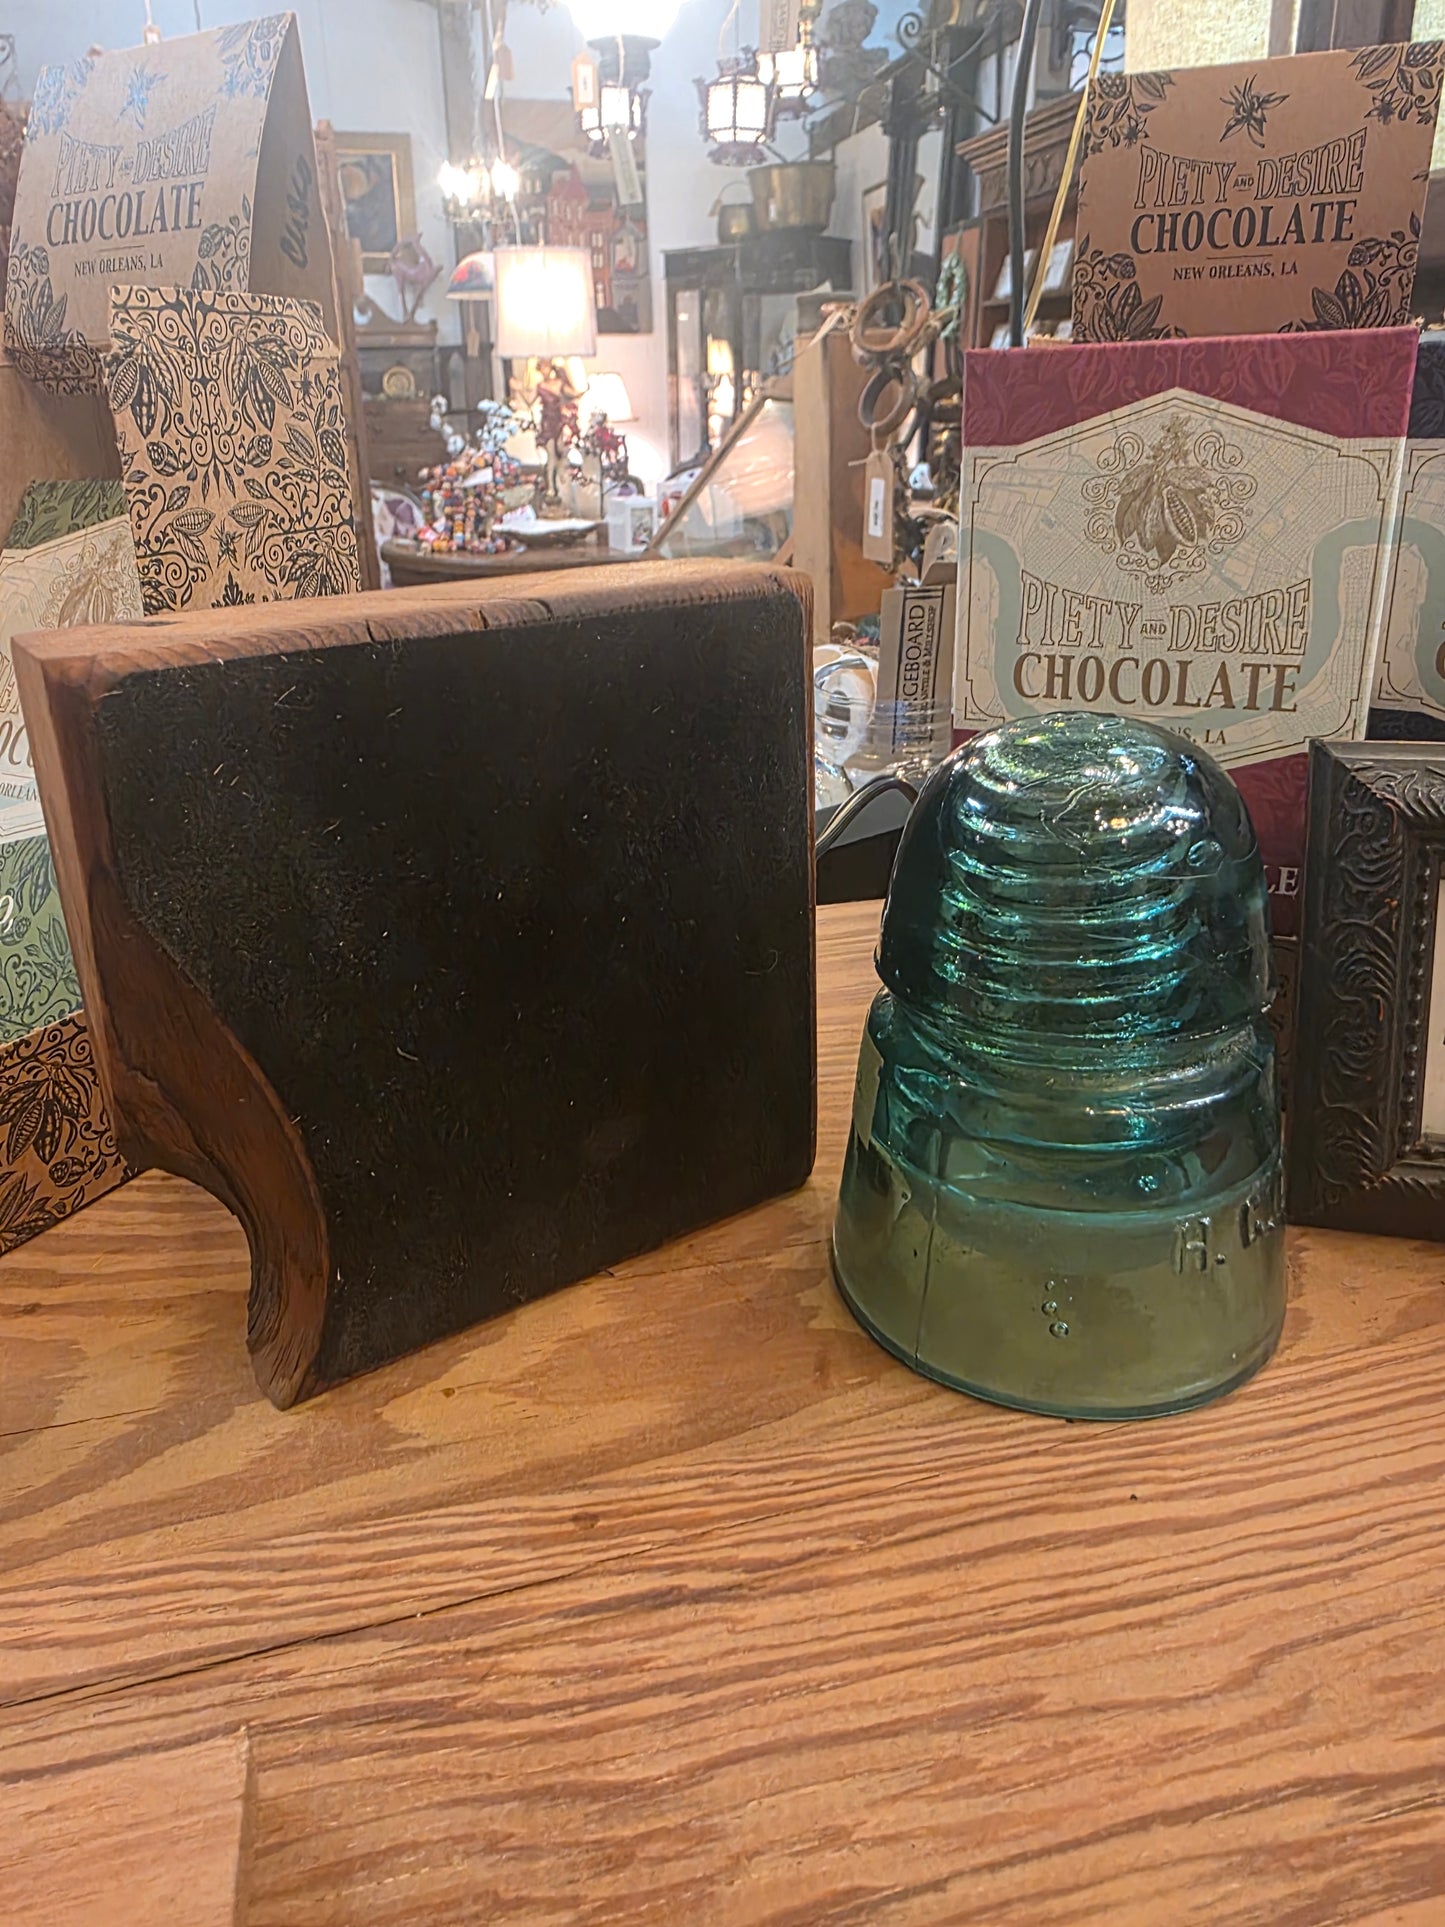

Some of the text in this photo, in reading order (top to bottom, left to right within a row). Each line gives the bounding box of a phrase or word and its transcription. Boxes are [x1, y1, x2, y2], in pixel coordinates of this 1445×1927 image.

[51, 130, 124, 197] PIETY
[131, 103, 216, 184] DESIRE
[1134, 127, 1367, 209] PIETY AND DESIRE
[46, 182, 205, 246] CHOCOLATE
[1131, 200, 1357, 254] CHOCOLATE
[74, 252, 163, 278] NEW ORLEANS, LA
[1173, 261, 1298, 281] NEW ORLEANS, LA
[1016, 569, 1311, 656] PIETY AND DESIRE
[1013, 652, 1301, 713] CHOCOLATE
[1204, 729, 1226, 745] LA
[0, 781, 40, 803] ORLEAN
